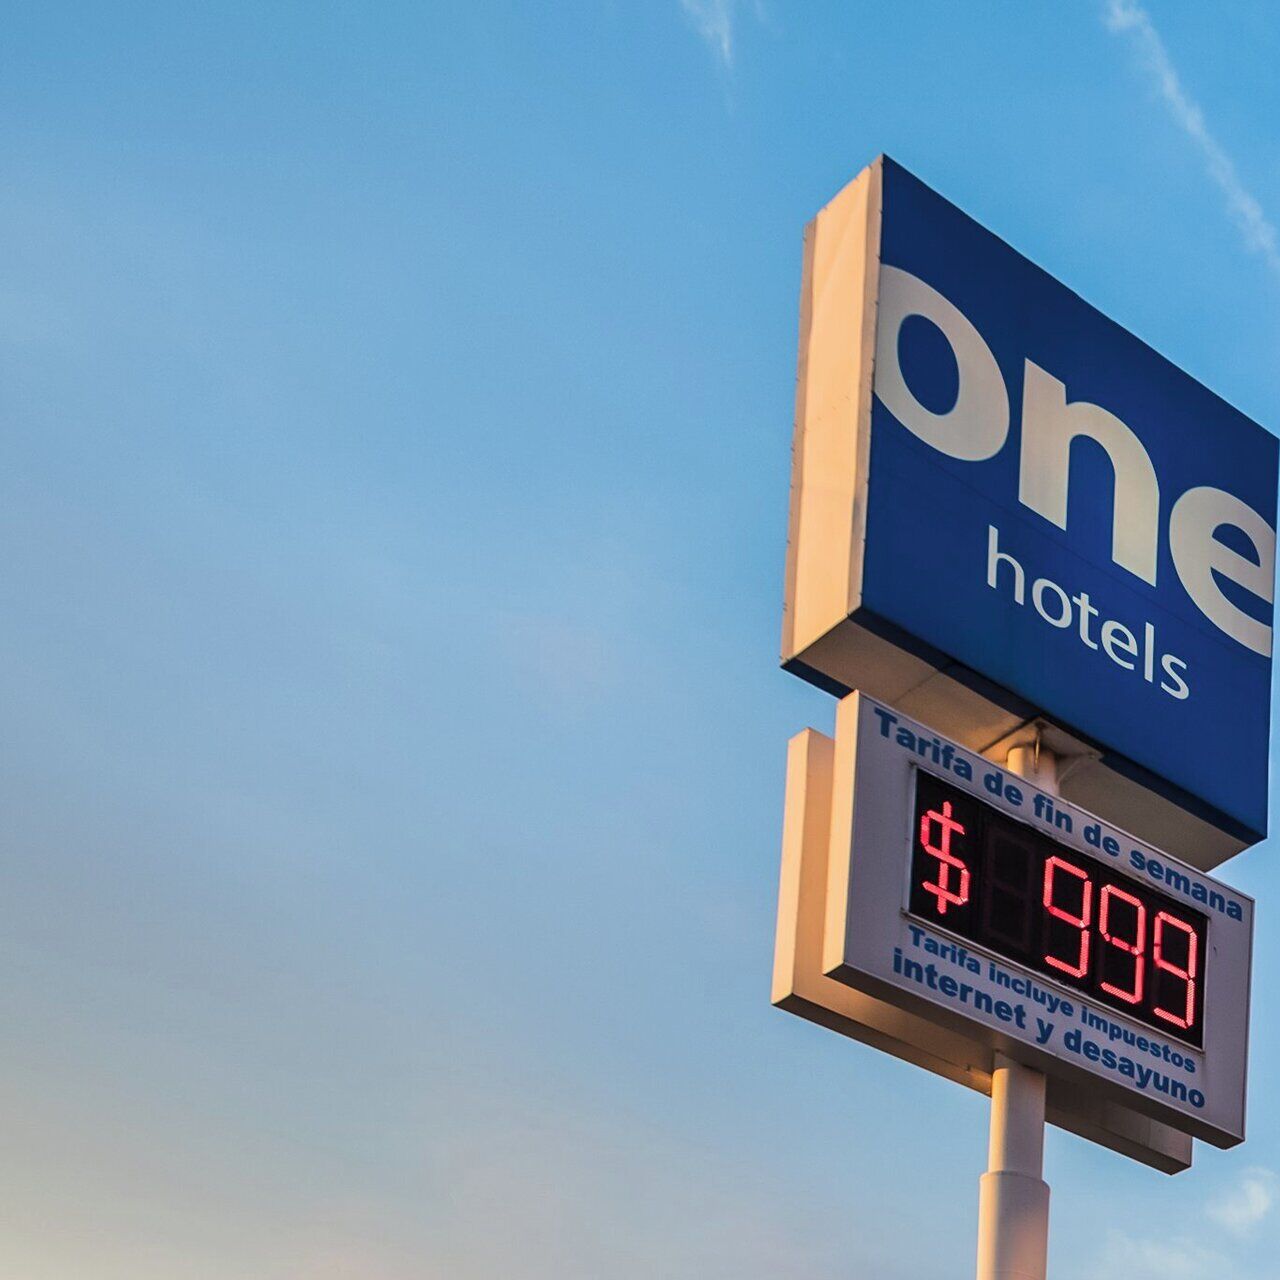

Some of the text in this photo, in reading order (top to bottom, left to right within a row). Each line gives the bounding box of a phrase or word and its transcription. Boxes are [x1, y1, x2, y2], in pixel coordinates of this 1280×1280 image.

[873, 264, 1277, 658] one
[986, 524, 1190, 700] hotels
[874, 706, 1243, 923] Tarifa de fin de semana
[908, 924, 1197, 1074] Tarifa incluye impuestos
[920, 800, 1198, 1030] $ 999
[893, 946, 1206, 1109] internet y desayuno
